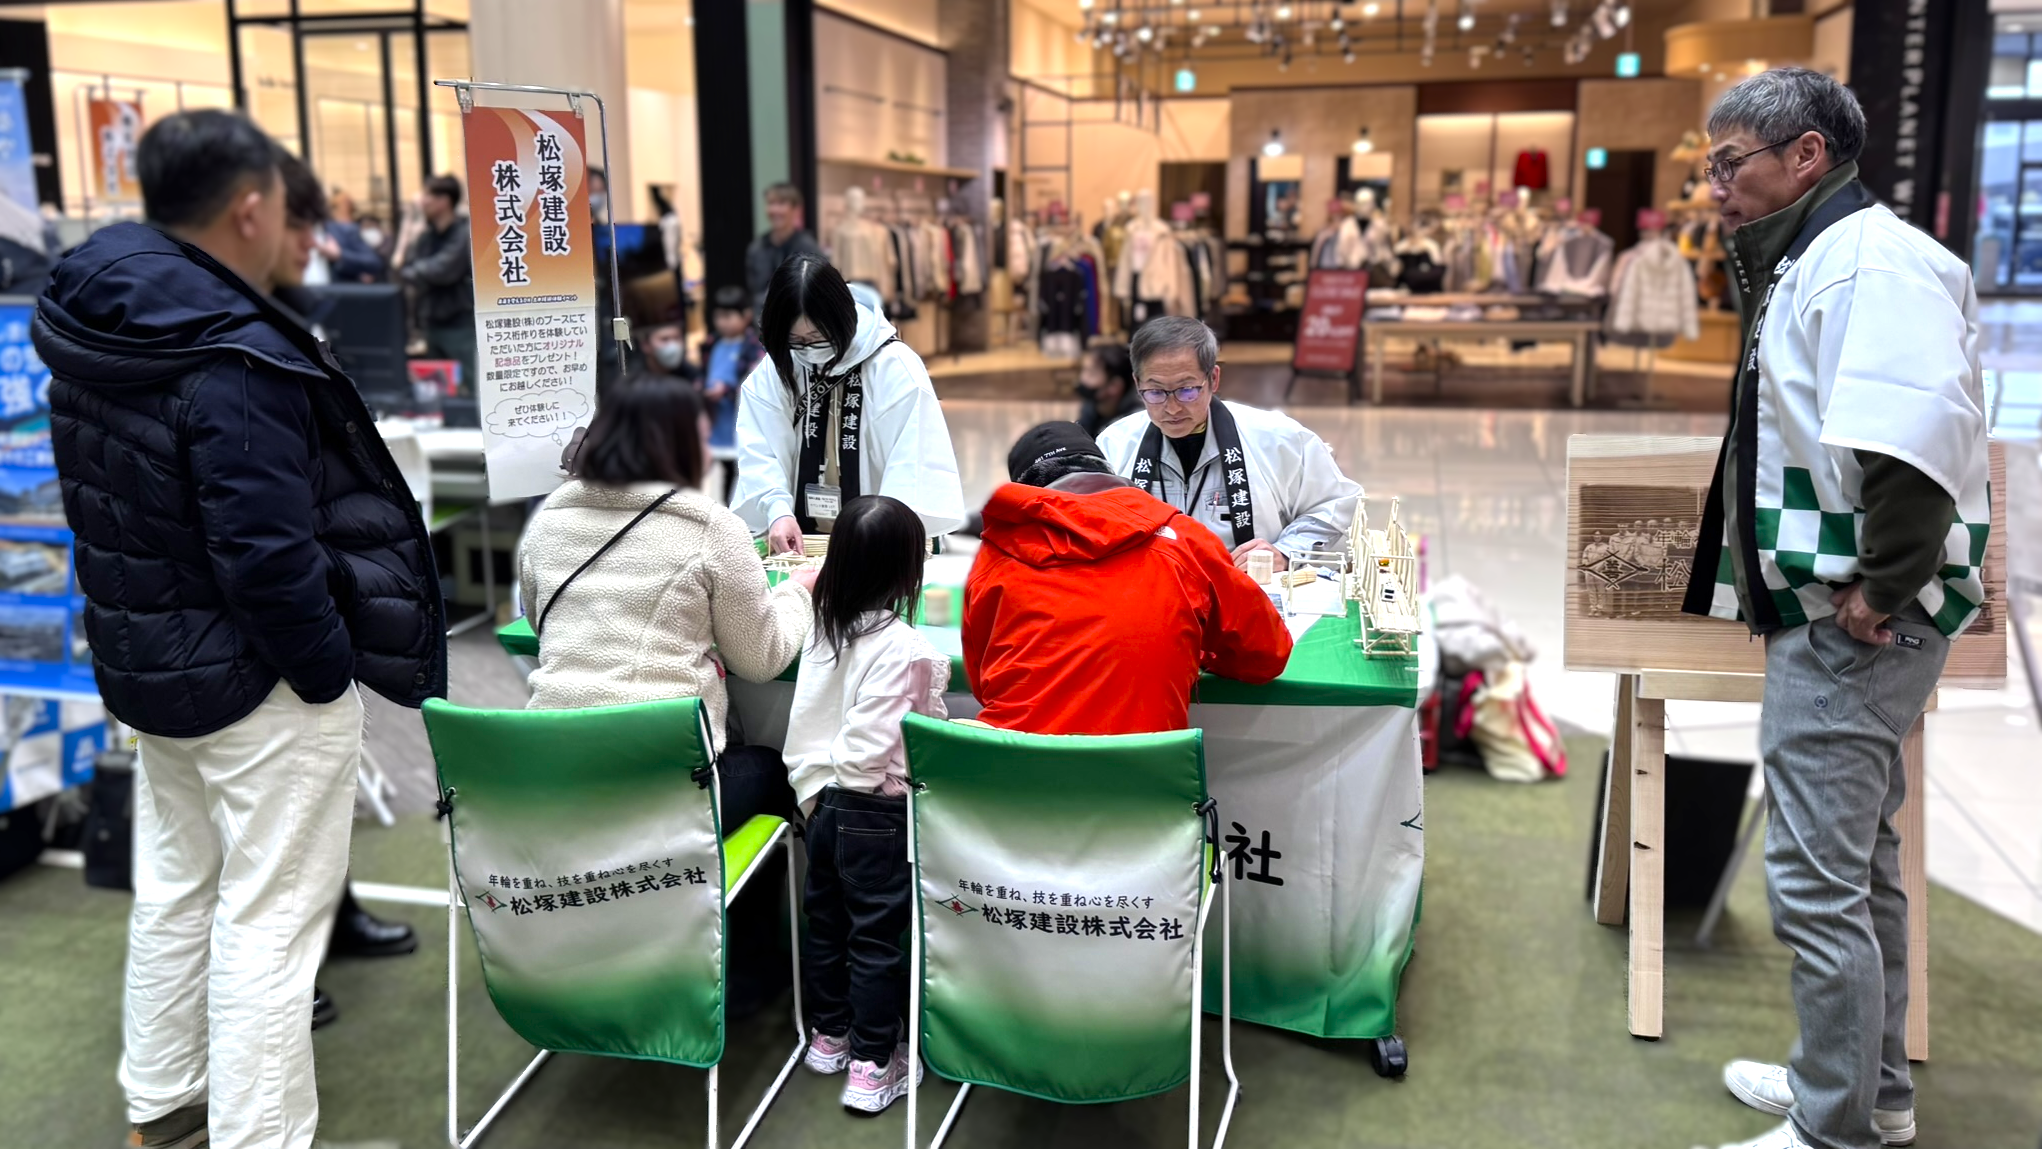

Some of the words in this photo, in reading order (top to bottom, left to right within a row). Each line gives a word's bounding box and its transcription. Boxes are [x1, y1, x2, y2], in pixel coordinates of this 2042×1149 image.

[536, 133, 567, 253] 松塚建設
[494, 163, 527, 284] 株式会社
[485, 313, 586, 330] 松塚建設(株)のブースにて
[486, 326, 588, 343] トラス桁作りを体験してい
[490, 339, 584, 355] ただいた方にオリジナル
[486, 363, 588, 381] 数量限定ですので、お早め
[514, 402, 560, 414] ぜひ体験しに
[841, 372, 862, 450] 松塚建設
[1224, 447, 1251, 528] 松塚建設
[488, 857, 674, 889] 年輪を重ね、技を重ね心を尽くす
[510, 866, 708, 916] 松塚建設株式会社
[958, 878, 1154, 909] 年輪を重ね、技を重ね心を尽くす
[981, 903, 1184, 941] 松塚建設株式会社
